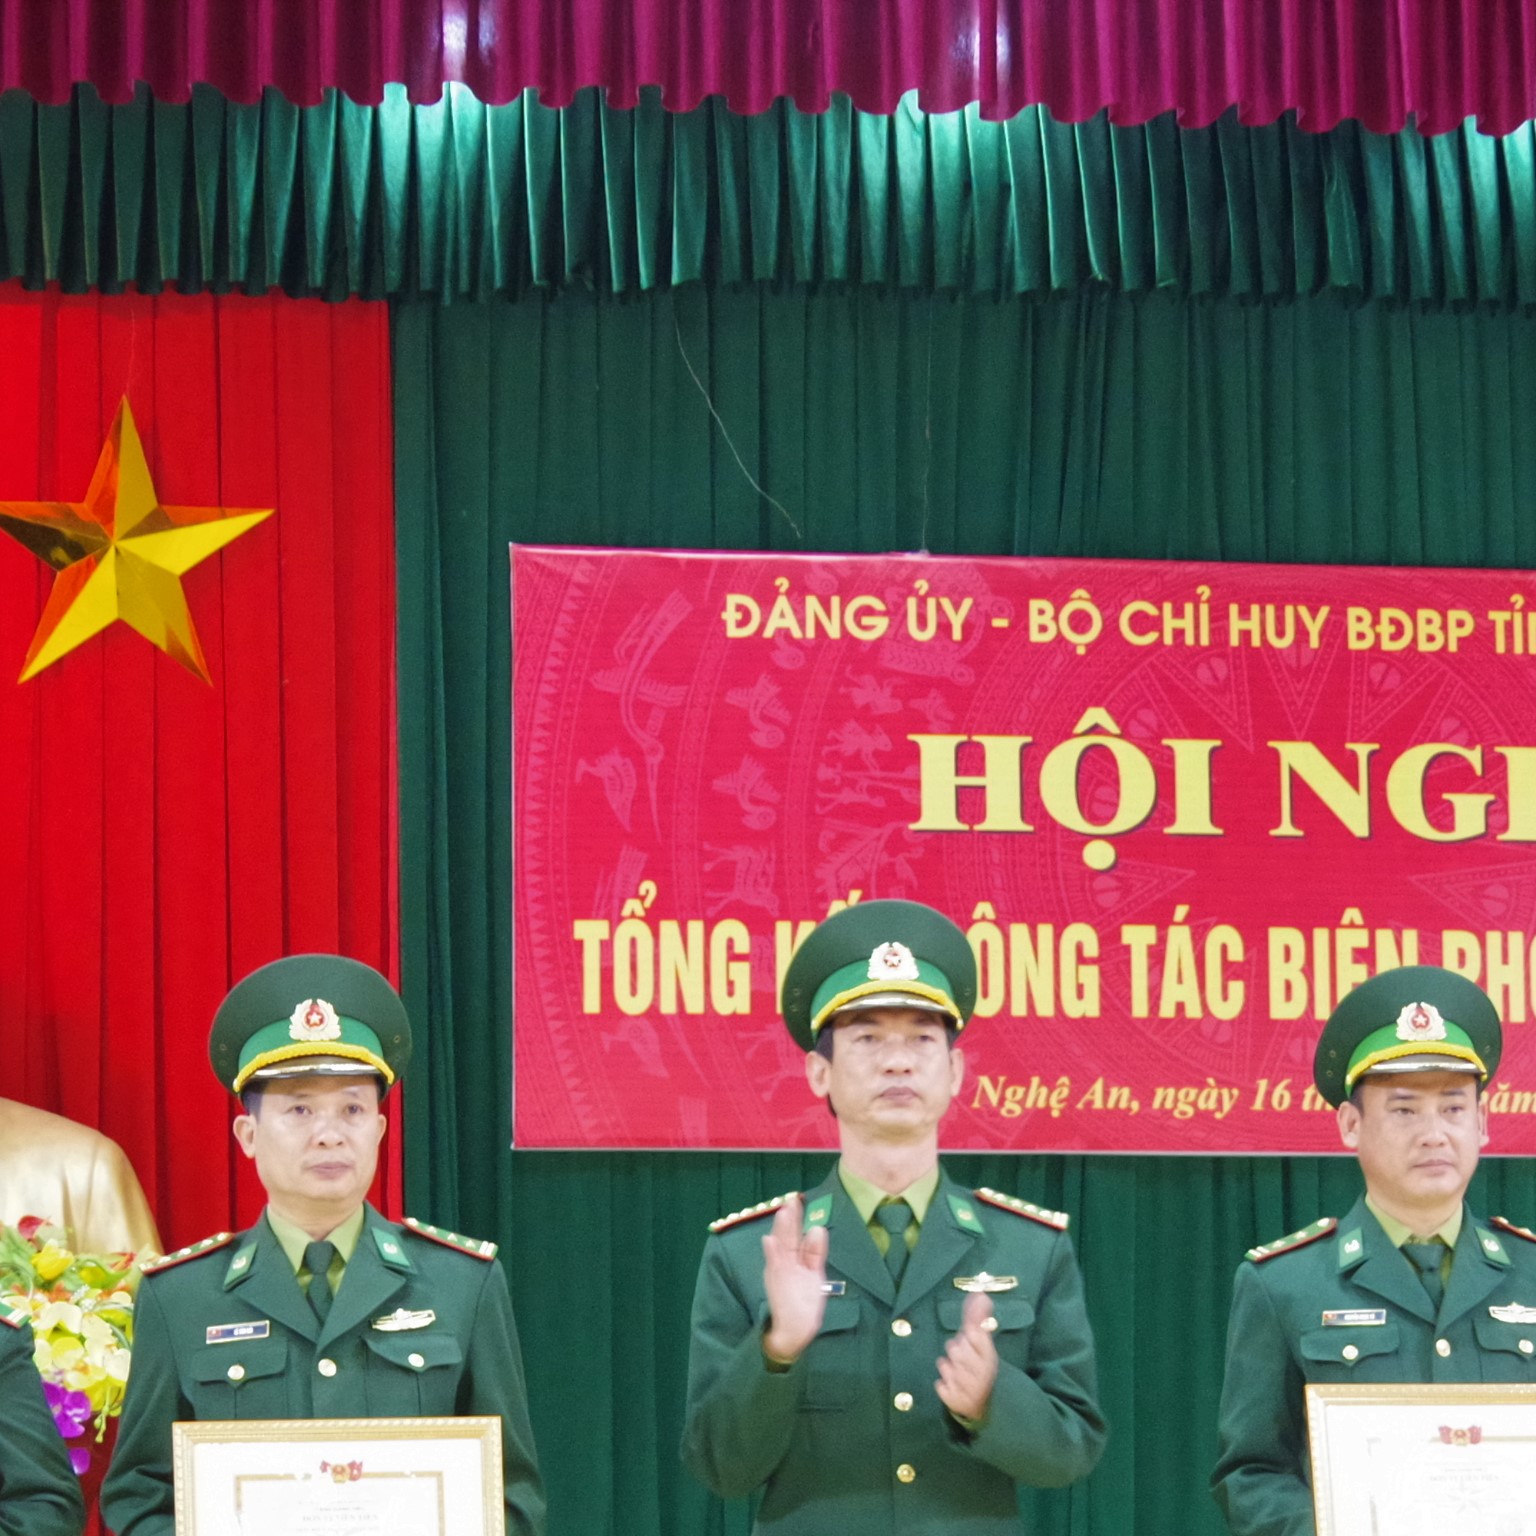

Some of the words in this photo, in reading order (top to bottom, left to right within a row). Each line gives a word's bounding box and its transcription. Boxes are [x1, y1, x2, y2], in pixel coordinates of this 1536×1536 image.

[720, 576, 890, 641] ĐẢNG
[906, 578, 974, 642] ỦY
[1028, 588, 1103, 656] BỘ
[1118, 585, 1211, 647] CHỈ
[1229, 603, 1330, 649] HUY
[1347, 606, 1475, 653] BĐBP
[906, 706, 1224, 871] HỘI
[573, 879, 752, 1016] TỔNG
[965, 901, 1101, 1019] ÔNG
[1121, 904, 1246, 1021] TÁC
[971, 1075, 1071, 1118] Nghệ
[1076, 1077, 1140, 1115] An,
[1151, 1077, 1240, 1120] ngày
[1251, 1078, 1292, 1112] 16
